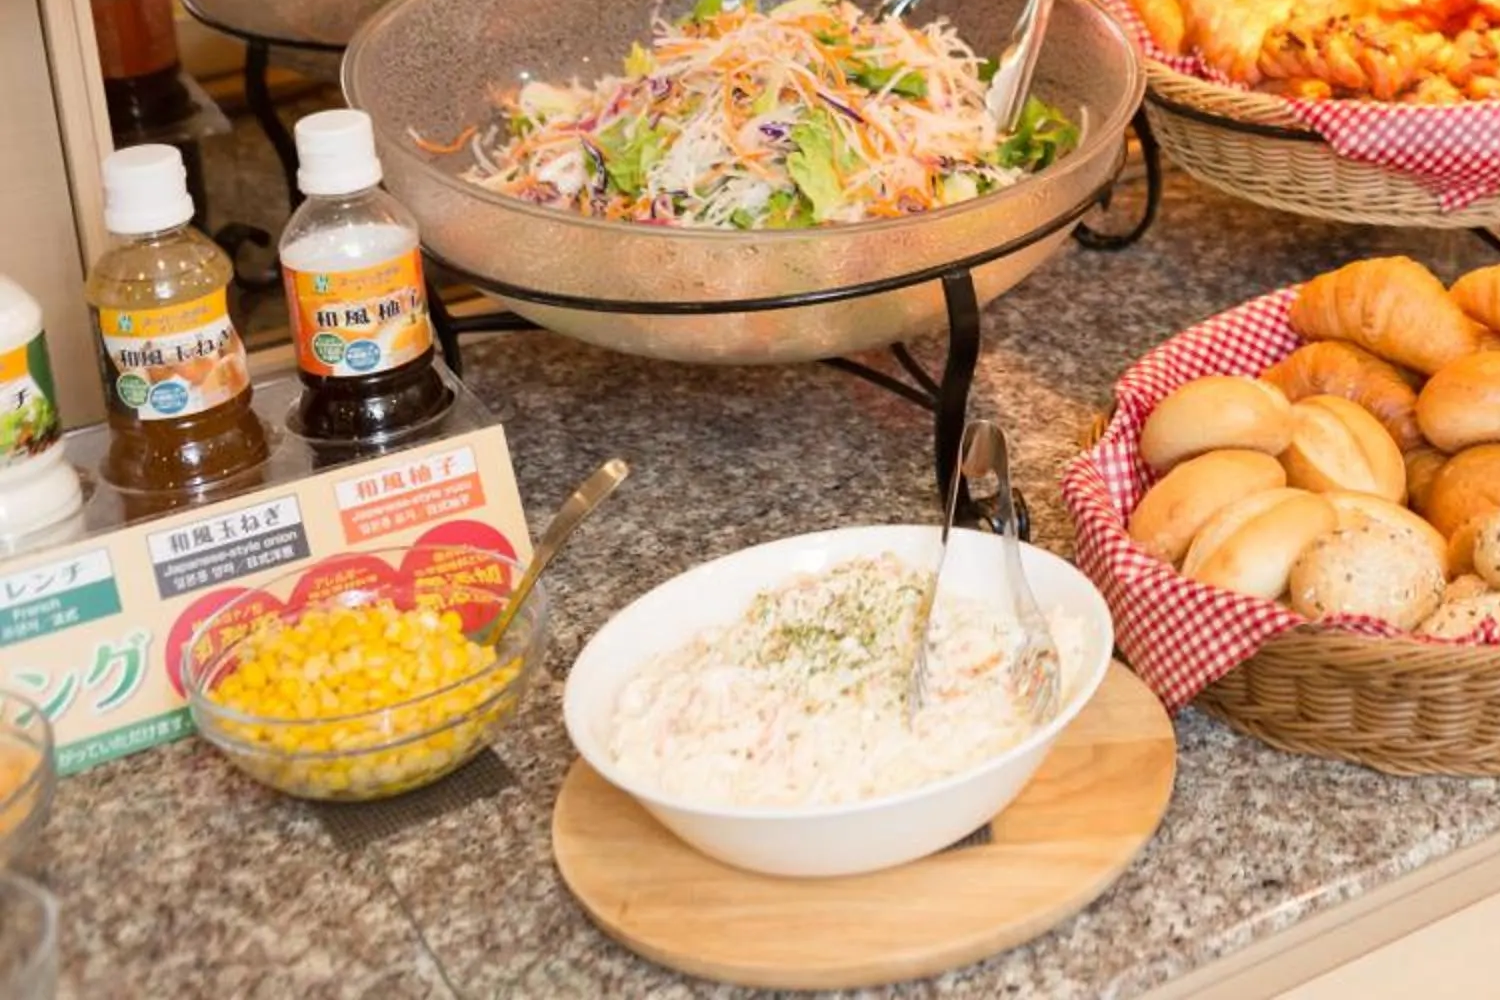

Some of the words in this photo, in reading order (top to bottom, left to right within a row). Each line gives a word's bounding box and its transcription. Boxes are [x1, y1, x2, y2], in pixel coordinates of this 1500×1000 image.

[169, 503, 282, 554] 和風玉ねぎ
[263, 530, 298, 550] onion
[5, 562, 81, 600] レンチ
